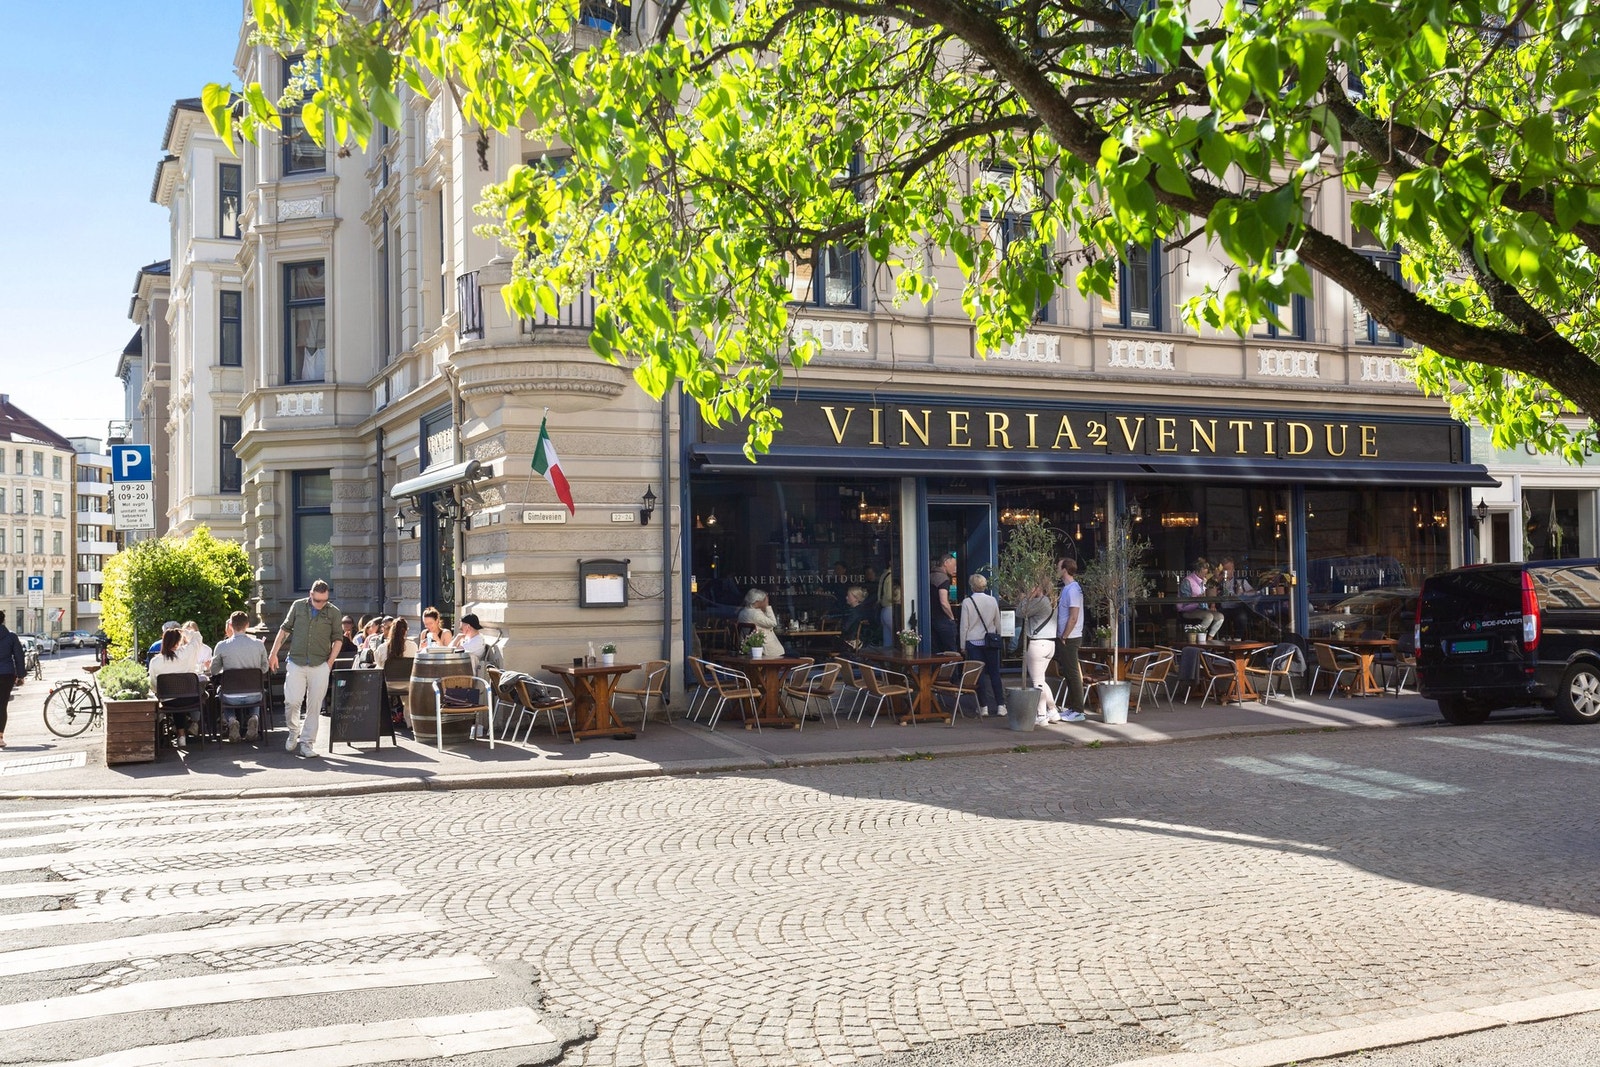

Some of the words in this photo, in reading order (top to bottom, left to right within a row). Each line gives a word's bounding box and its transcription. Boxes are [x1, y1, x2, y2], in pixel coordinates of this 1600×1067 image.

[820, 406, 1082, 449] VINERIA
[1116, 416, 1378, 457] VENTIDUE
[122, 450, 142, 477] P
[528, 512, 562, 521] Gimleveien
[31, 577, 40, 588] P
[734, 575, 791, 585] VINERIA
[799, 574, 866, 584] VENTIDUE
[1481, 618, 1522, 627] SIDE-POWER
